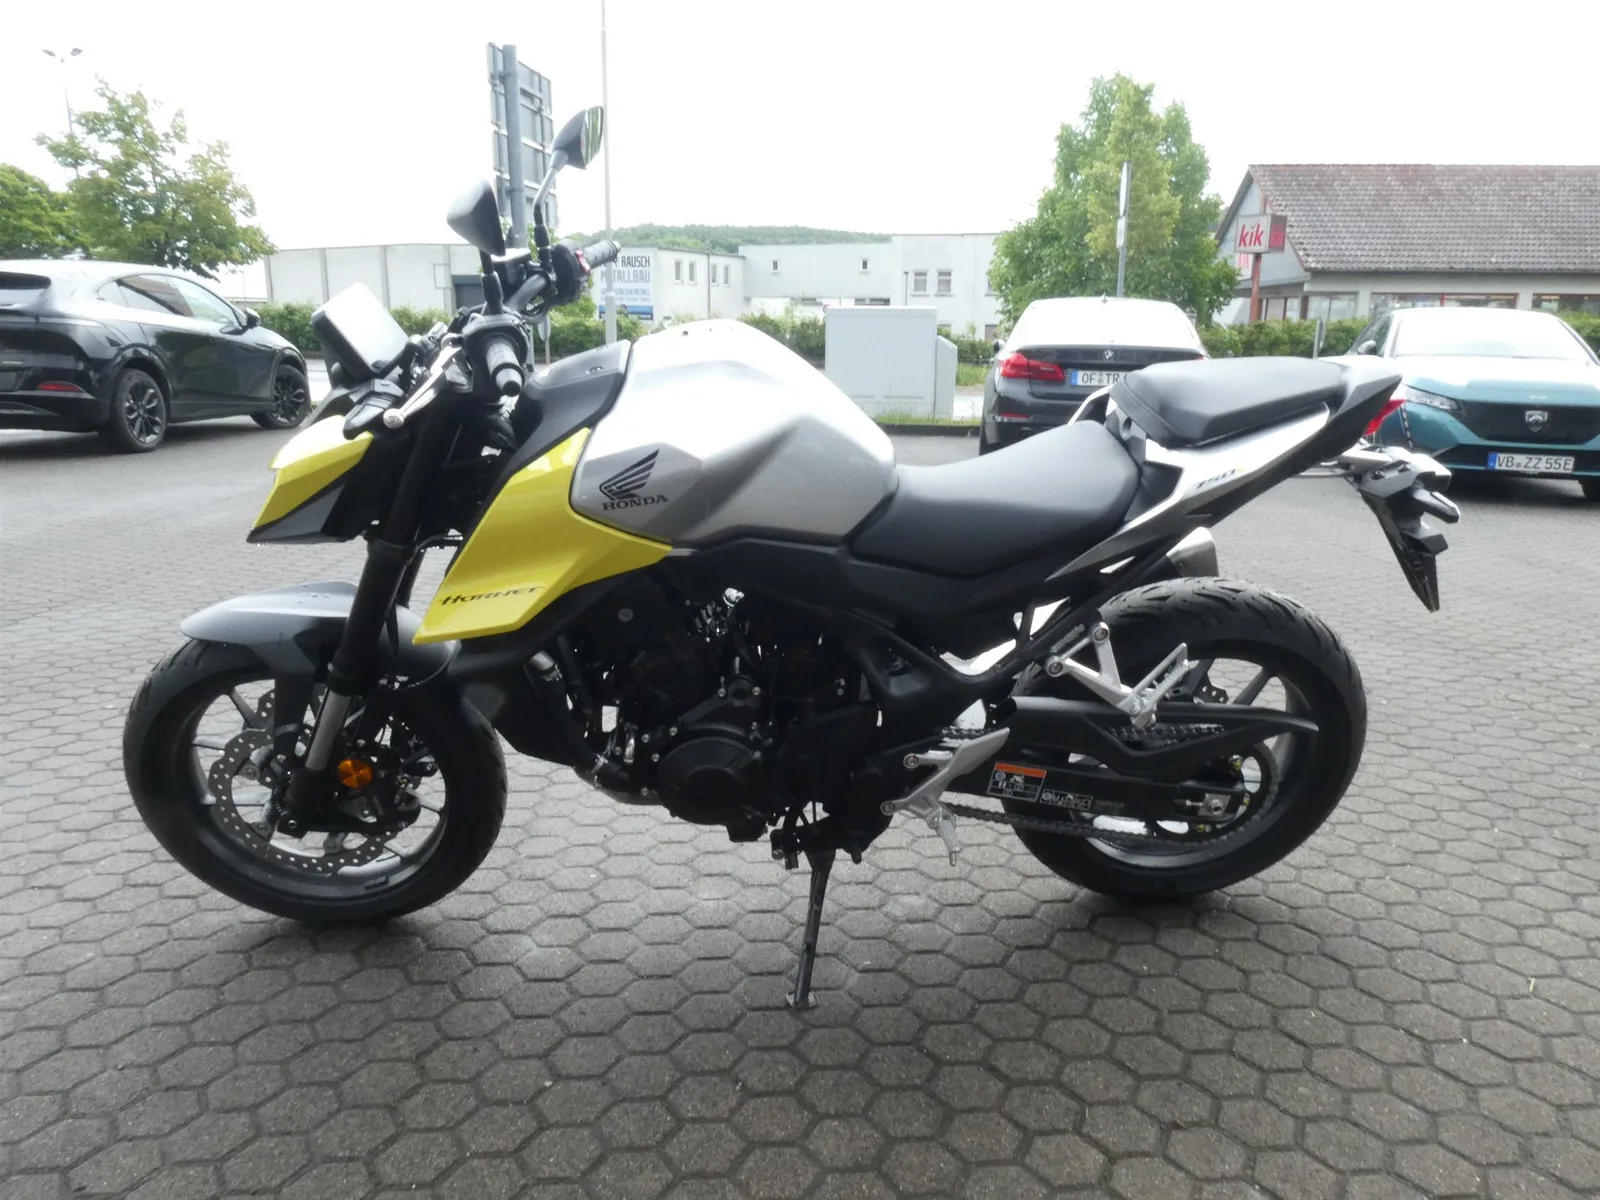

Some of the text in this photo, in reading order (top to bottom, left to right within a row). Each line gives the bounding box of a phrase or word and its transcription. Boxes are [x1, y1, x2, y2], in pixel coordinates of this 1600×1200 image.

[621, 255, 651, 268] RAUSCH
[600, 269, 651, 283] MTALLBAU
[1081, 372, 1097, 384] OF
[1105, 372, 1120, 384] TR
[1497, 455, 1573, 471] VB ZZ 55E
[601, 494, 669, 511] HONDA
[439, 586, 544, 606] HORNET
